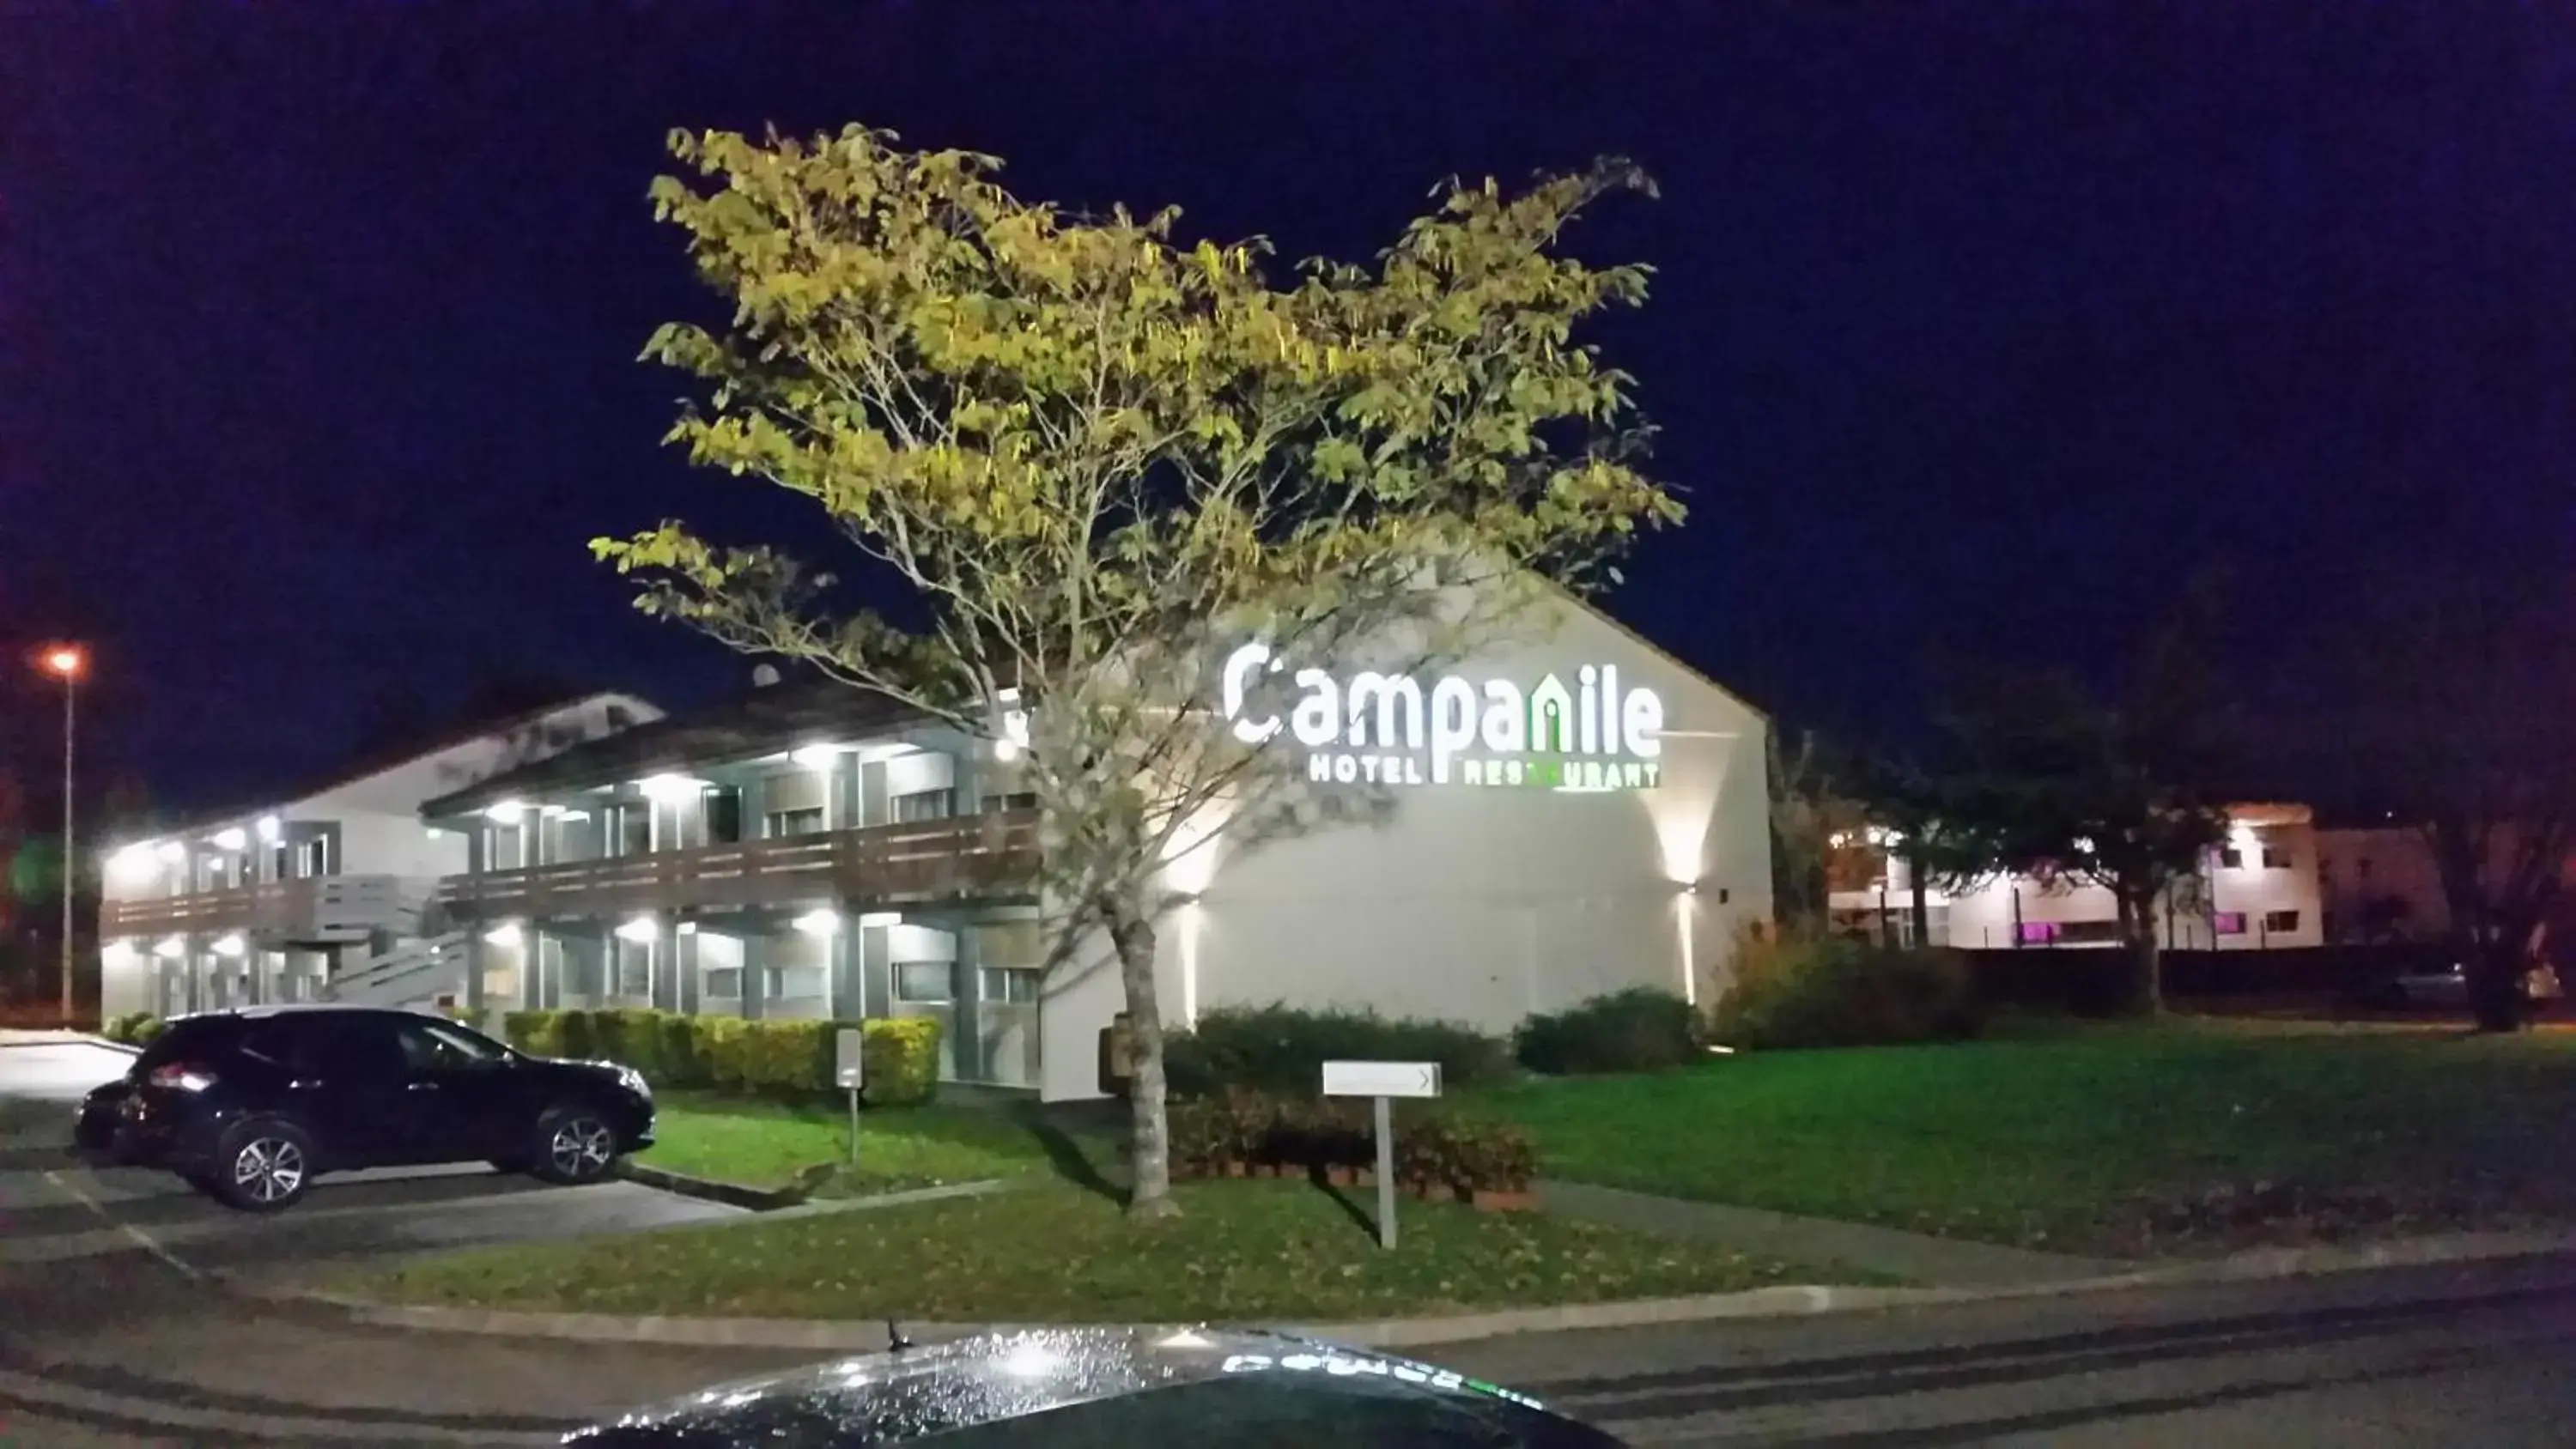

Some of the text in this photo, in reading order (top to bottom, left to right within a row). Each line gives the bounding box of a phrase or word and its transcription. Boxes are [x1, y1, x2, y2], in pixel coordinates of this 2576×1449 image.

[1224, 643, 1663, 784] Campanile
[1309, 754, 1660, 788] HOTEL RESURANT
